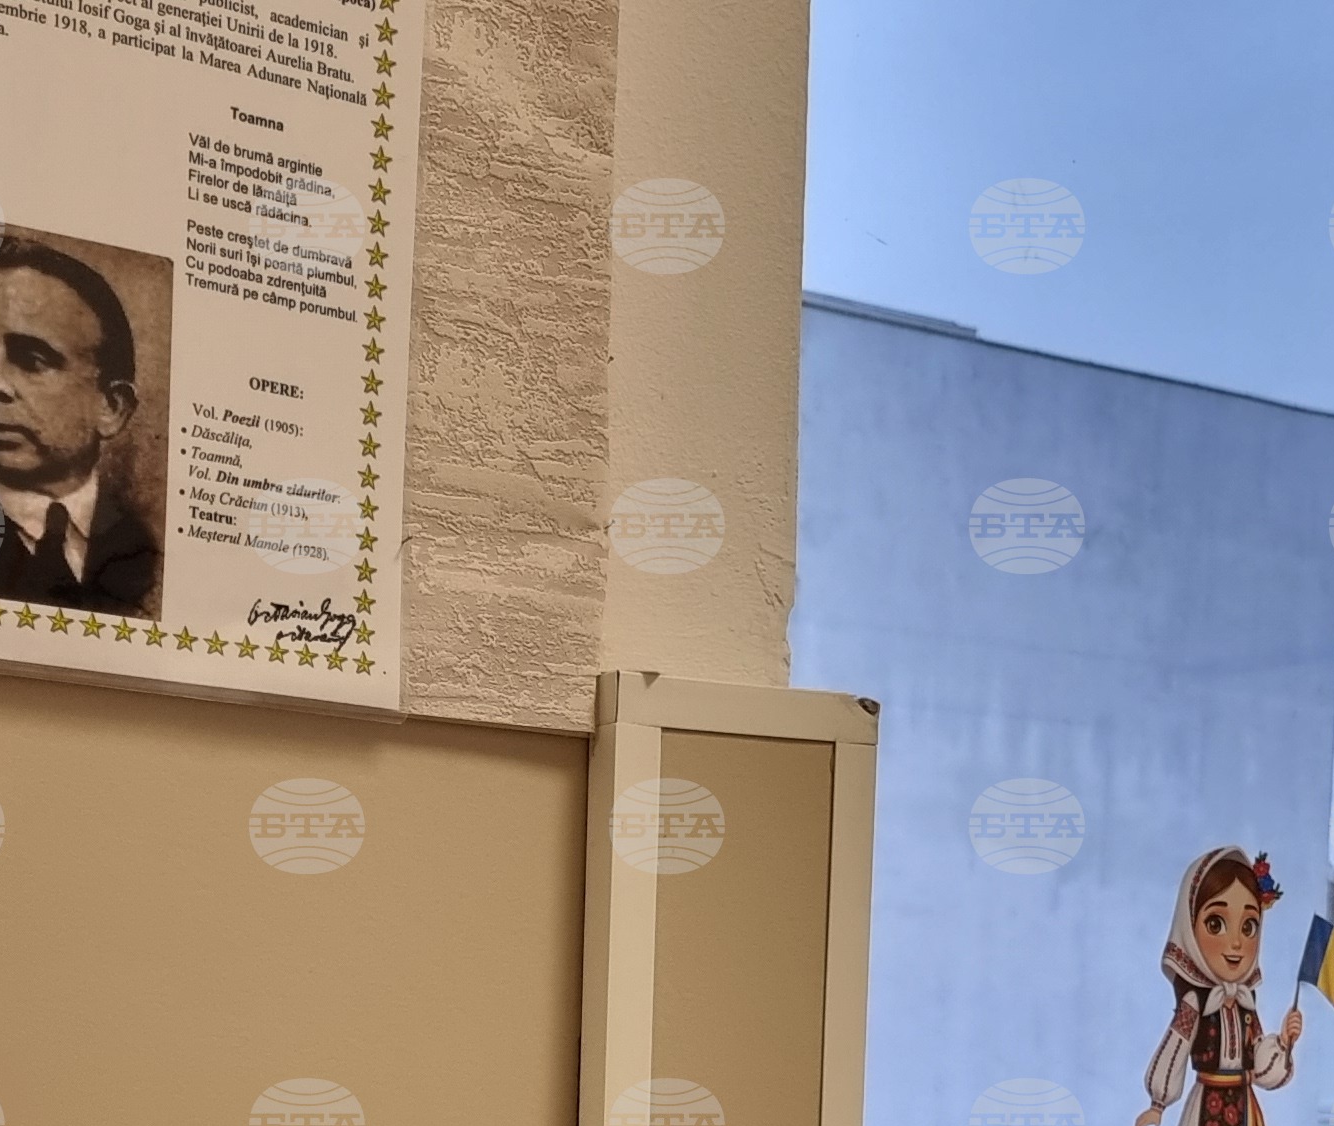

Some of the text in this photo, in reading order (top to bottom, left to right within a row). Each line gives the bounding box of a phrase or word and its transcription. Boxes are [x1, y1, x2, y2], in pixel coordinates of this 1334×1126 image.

[226, 17, 337, 59] Unirii 1918.
[270, 12, 348, 41] academician
[54, 13, 301, 89] 1918, participat la Marea Adunare
[113, 8, 354, 83] Goga Aurelia Bratu.
[230, 106, 284, 132] Toamna
[189, 132, 322, 177] Văl brumă argintie
[189, 150, 283, 185] Mi-a împodobit
[188, 168, 229, 190] Firelor
[203, 193, 252, 213] se uscă
[187, 219, 224, 239] Peste
[187, 237, 243, 261] Norii suri
[186, 255, 263, 284] Cu podoaba
[185, 272, 357, 323] Tremură câmp porumbul.
[249, 377, 303, 399] OPERE:
[222, 409, 303, 437] Poezii (1905):
[215, 470, 283, 493] Din umbra
[189, 505, 237, 526] Teatru:
